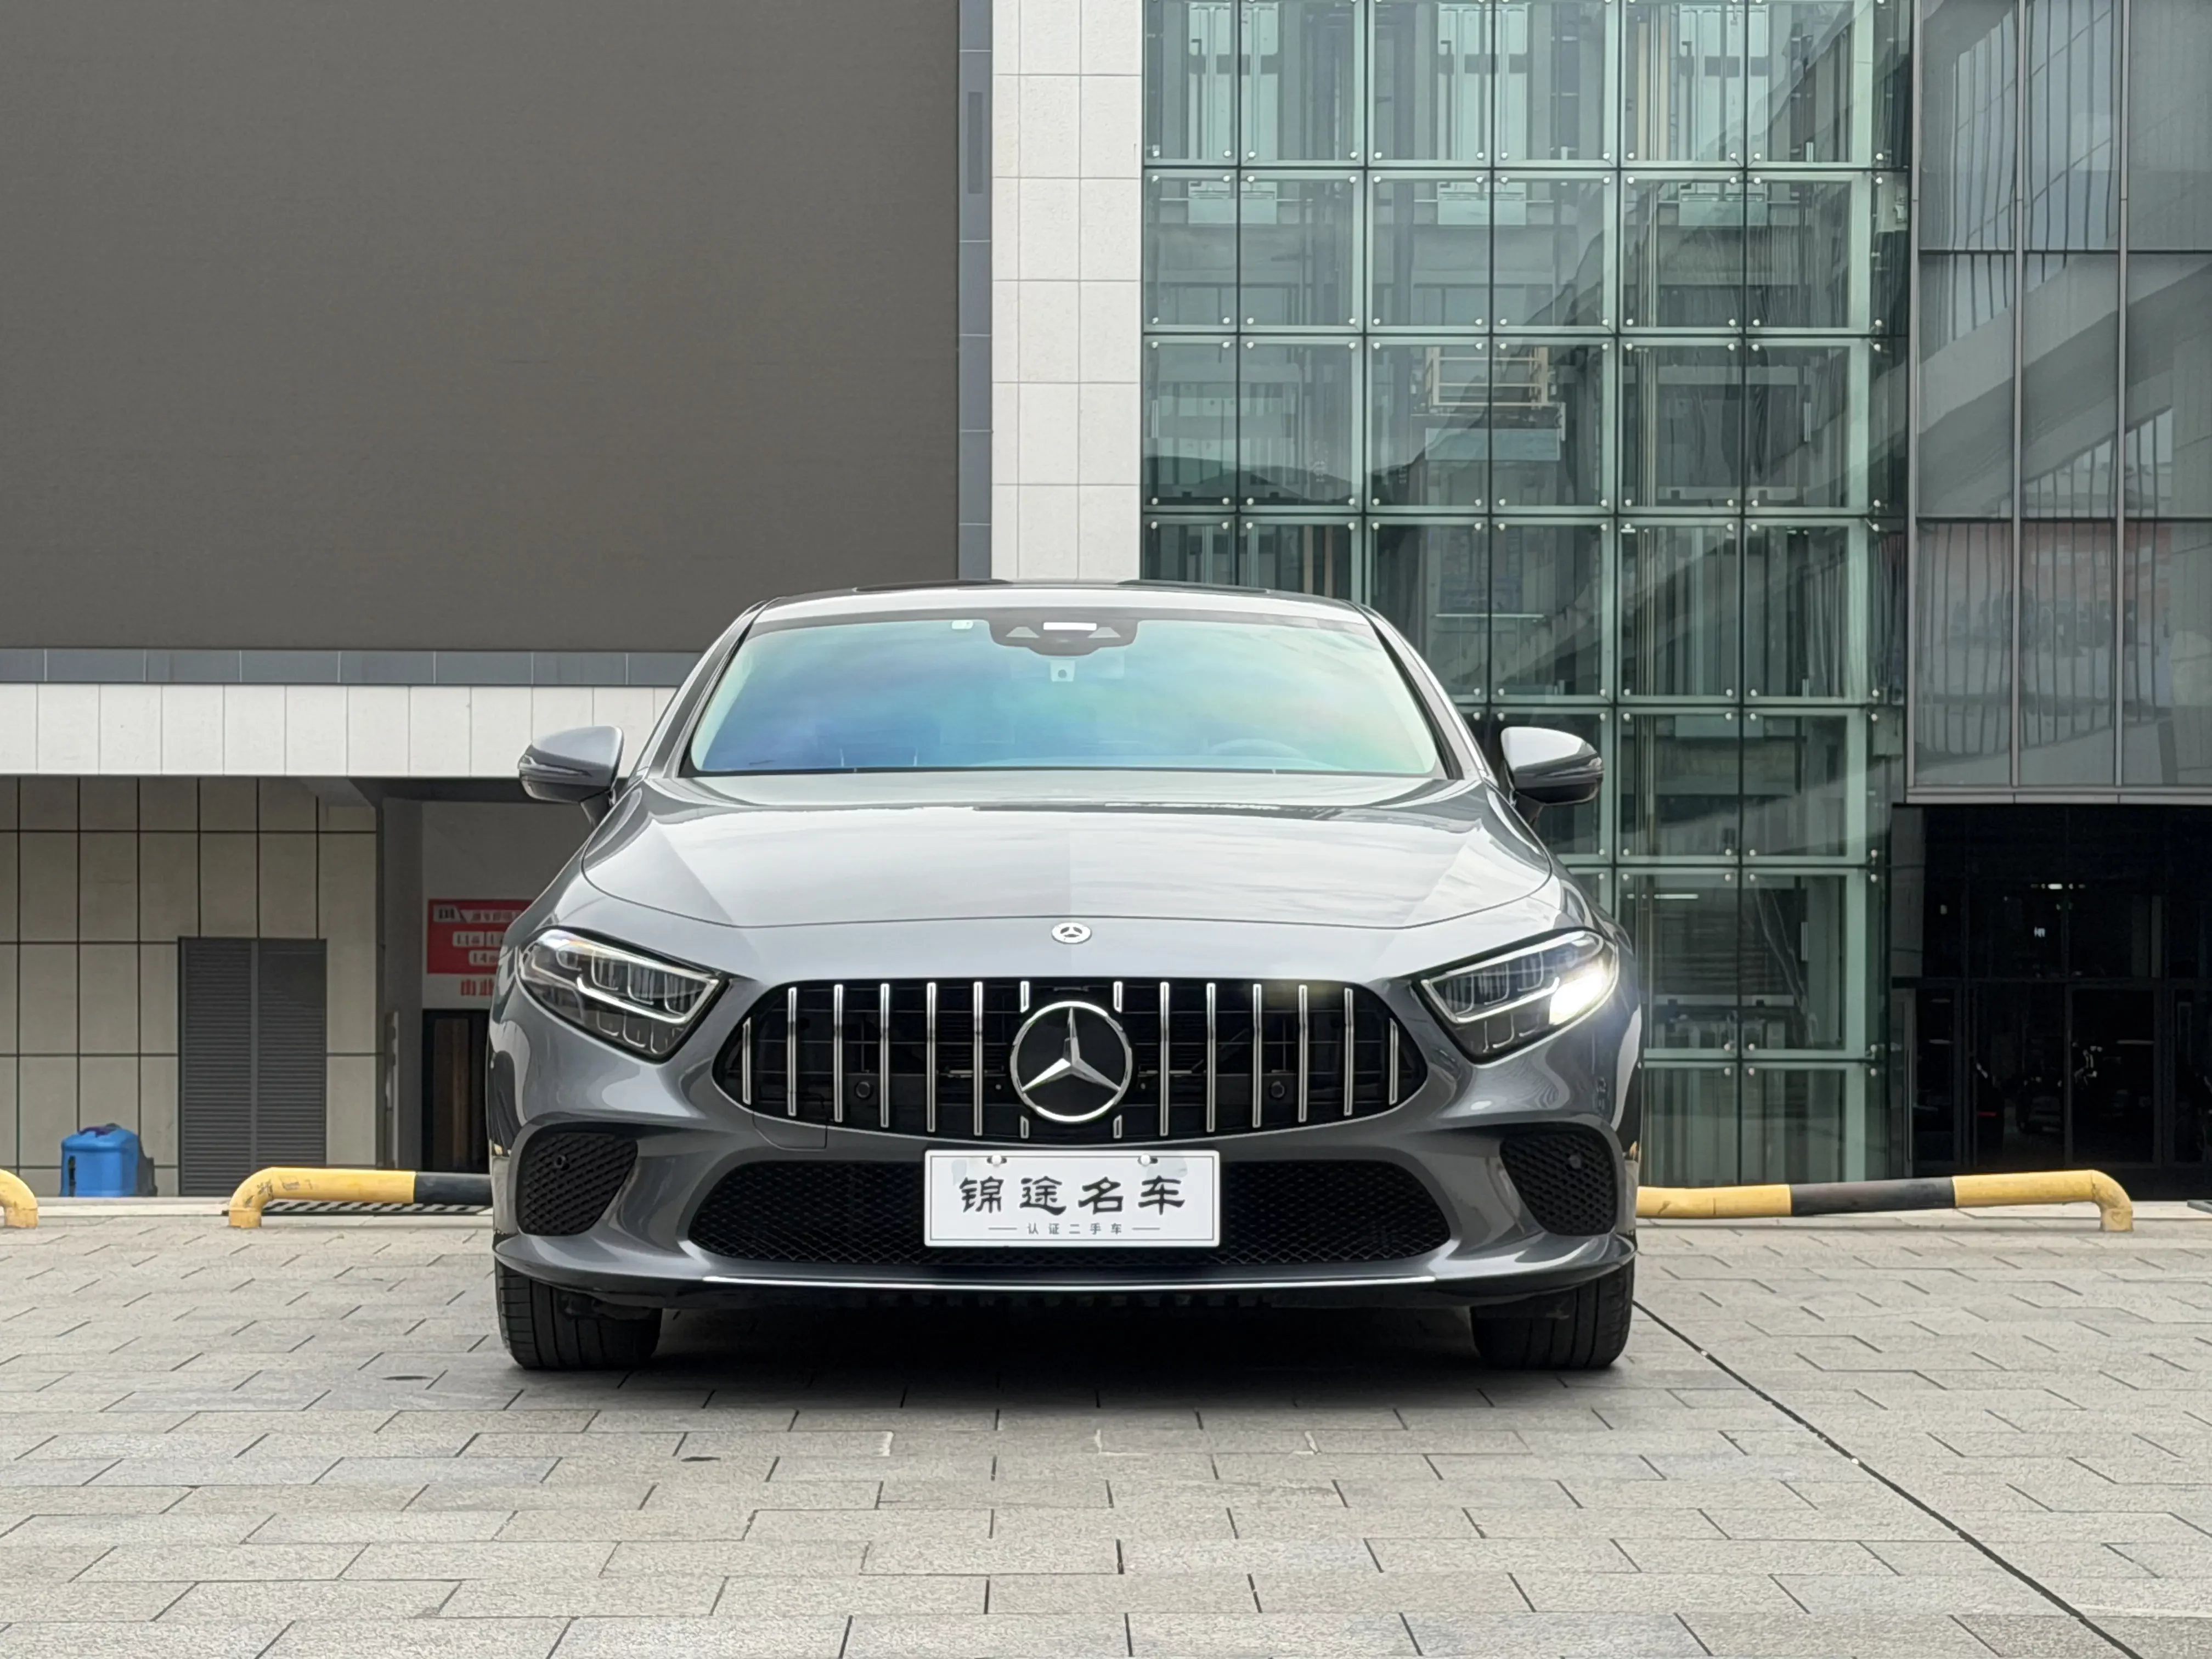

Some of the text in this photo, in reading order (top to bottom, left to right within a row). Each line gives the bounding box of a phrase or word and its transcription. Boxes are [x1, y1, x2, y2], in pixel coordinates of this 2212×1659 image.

[959, 1175, 1185, 1216] 锦途名车
[1027, 1222, 1122, 1235] 认证二手车
